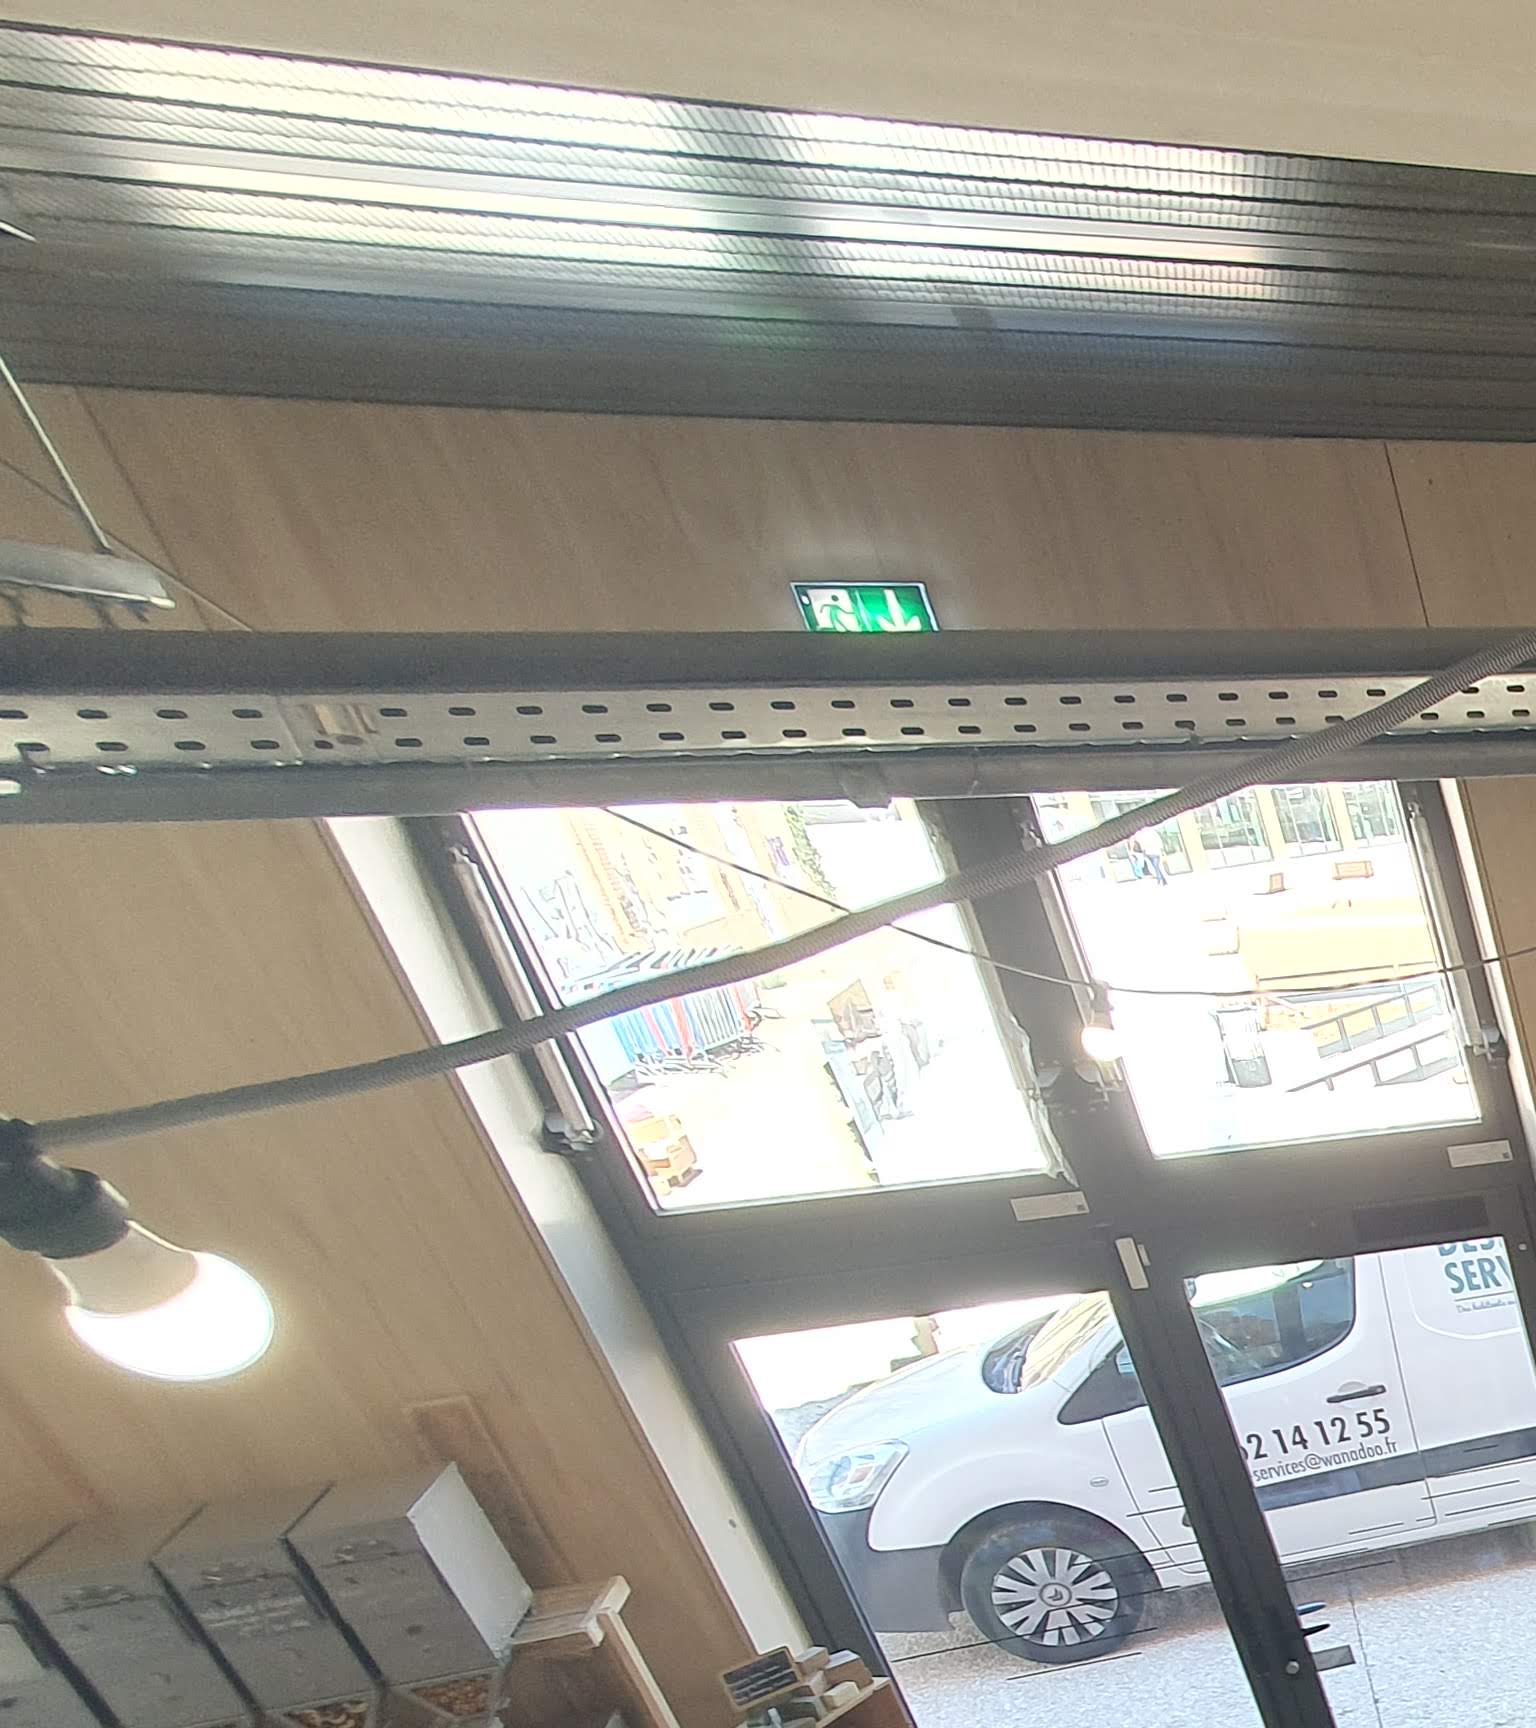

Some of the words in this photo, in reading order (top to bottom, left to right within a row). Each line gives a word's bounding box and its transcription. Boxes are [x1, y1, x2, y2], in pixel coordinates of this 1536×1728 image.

[1272, 1424, 1308, 1454] 14
[1314, 1416, 1351, 1446] 12
[1357, 1407, 1391, 1438] 55
